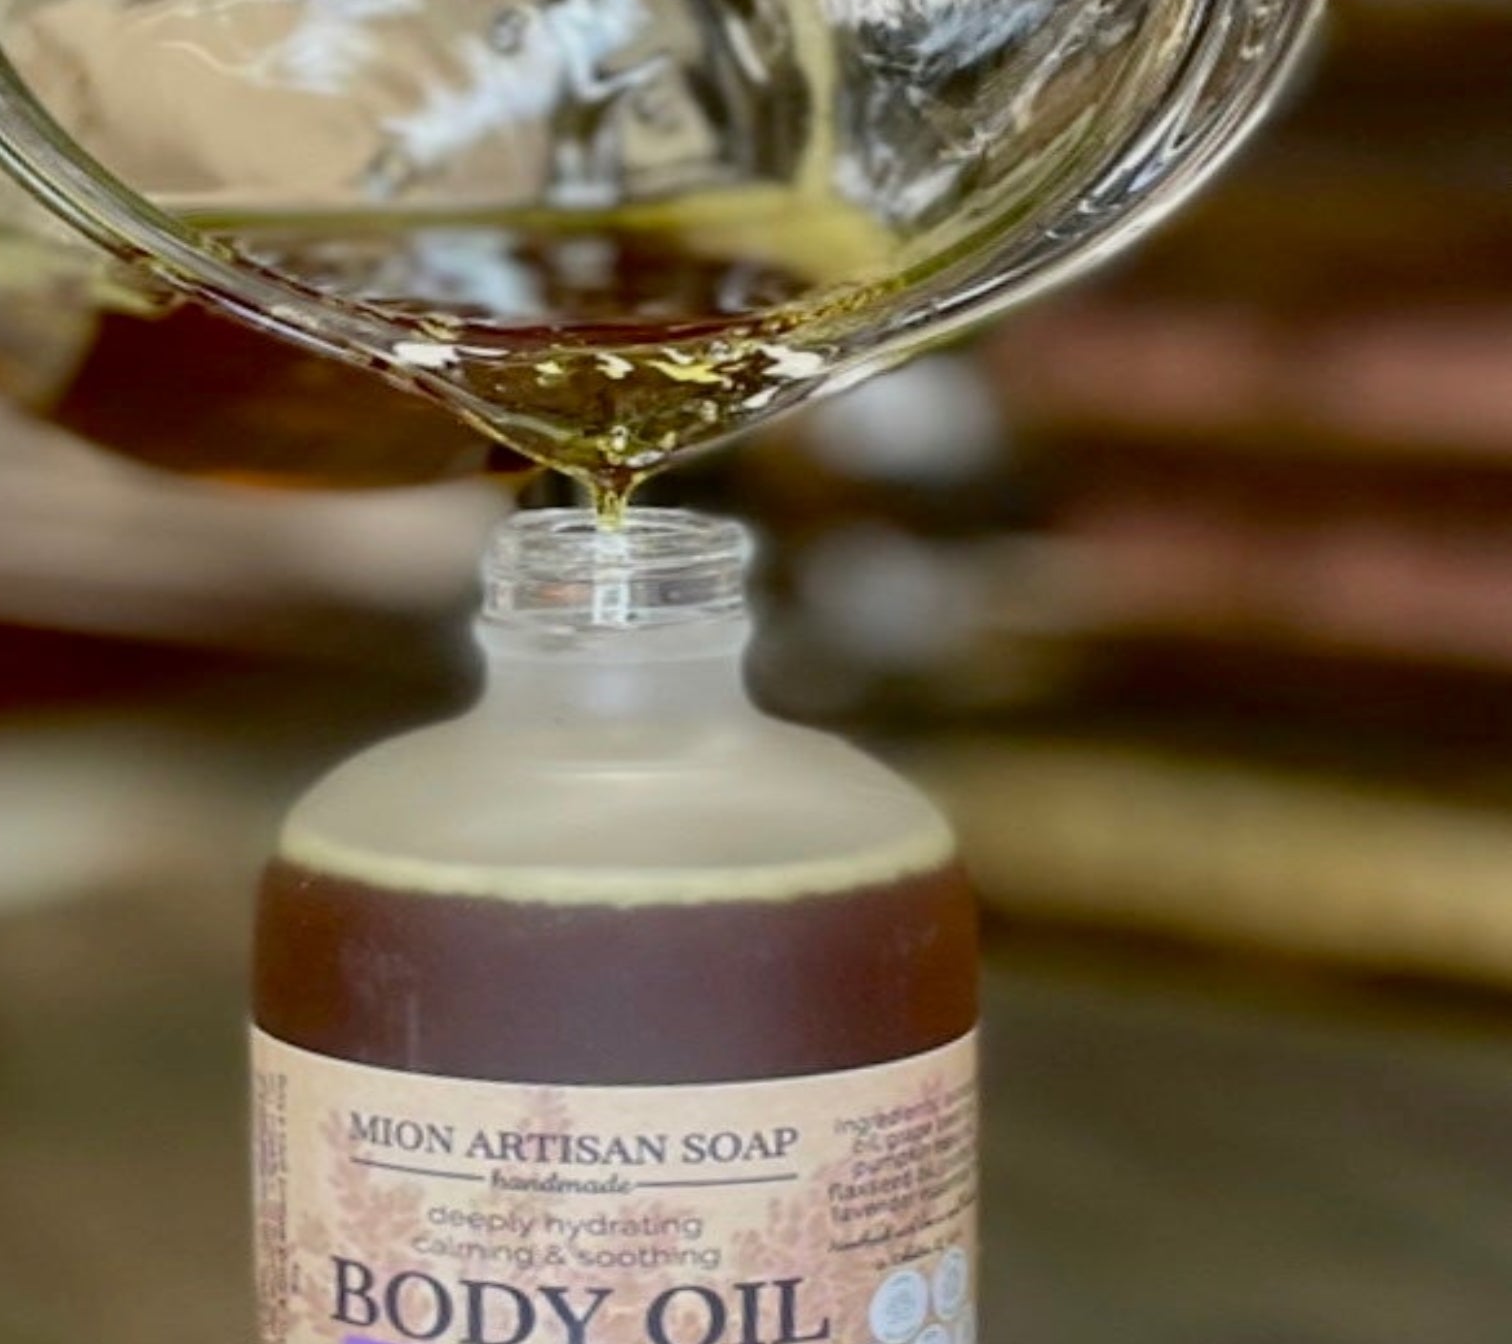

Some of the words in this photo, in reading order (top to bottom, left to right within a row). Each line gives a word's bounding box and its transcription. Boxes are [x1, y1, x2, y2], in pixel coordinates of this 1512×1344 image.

[349, 1111, 454, 1154] MION
[465, 1129, 668, 1166] ARTISAN
[681, 1127, 799, 1164] SOAP
[492, 1168, 635, 1195] handmade
[427, 1206, 535, 1238] deeply
[544, 1212, 703, 1243] hydrating
